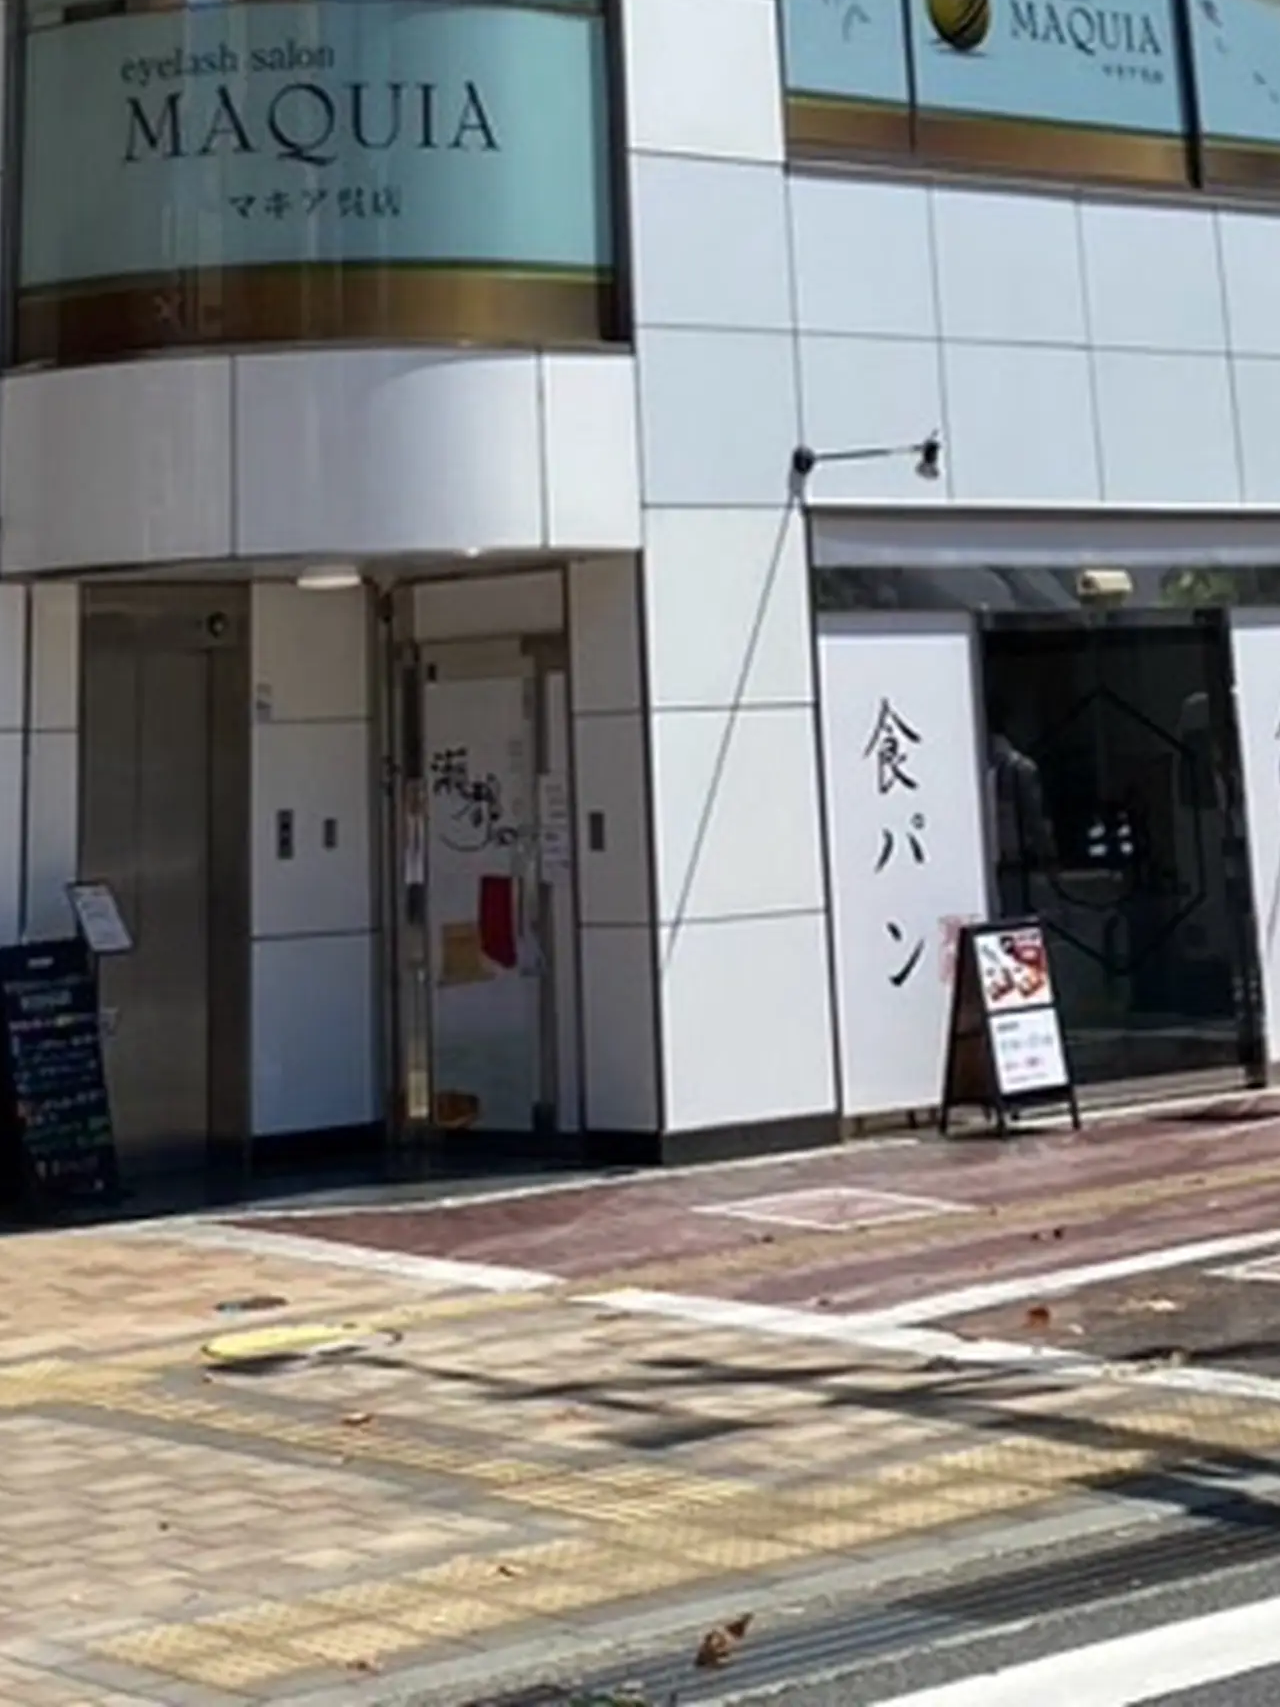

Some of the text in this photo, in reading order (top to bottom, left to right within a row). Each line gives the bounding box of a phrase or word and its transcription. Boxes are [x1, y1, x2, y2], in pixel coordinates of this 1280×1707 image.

[120, 39, 335, 84] eyelash salon
[123, 80, 502, 167] MAQUIA
[863, 697, 926, 988] 食パン
